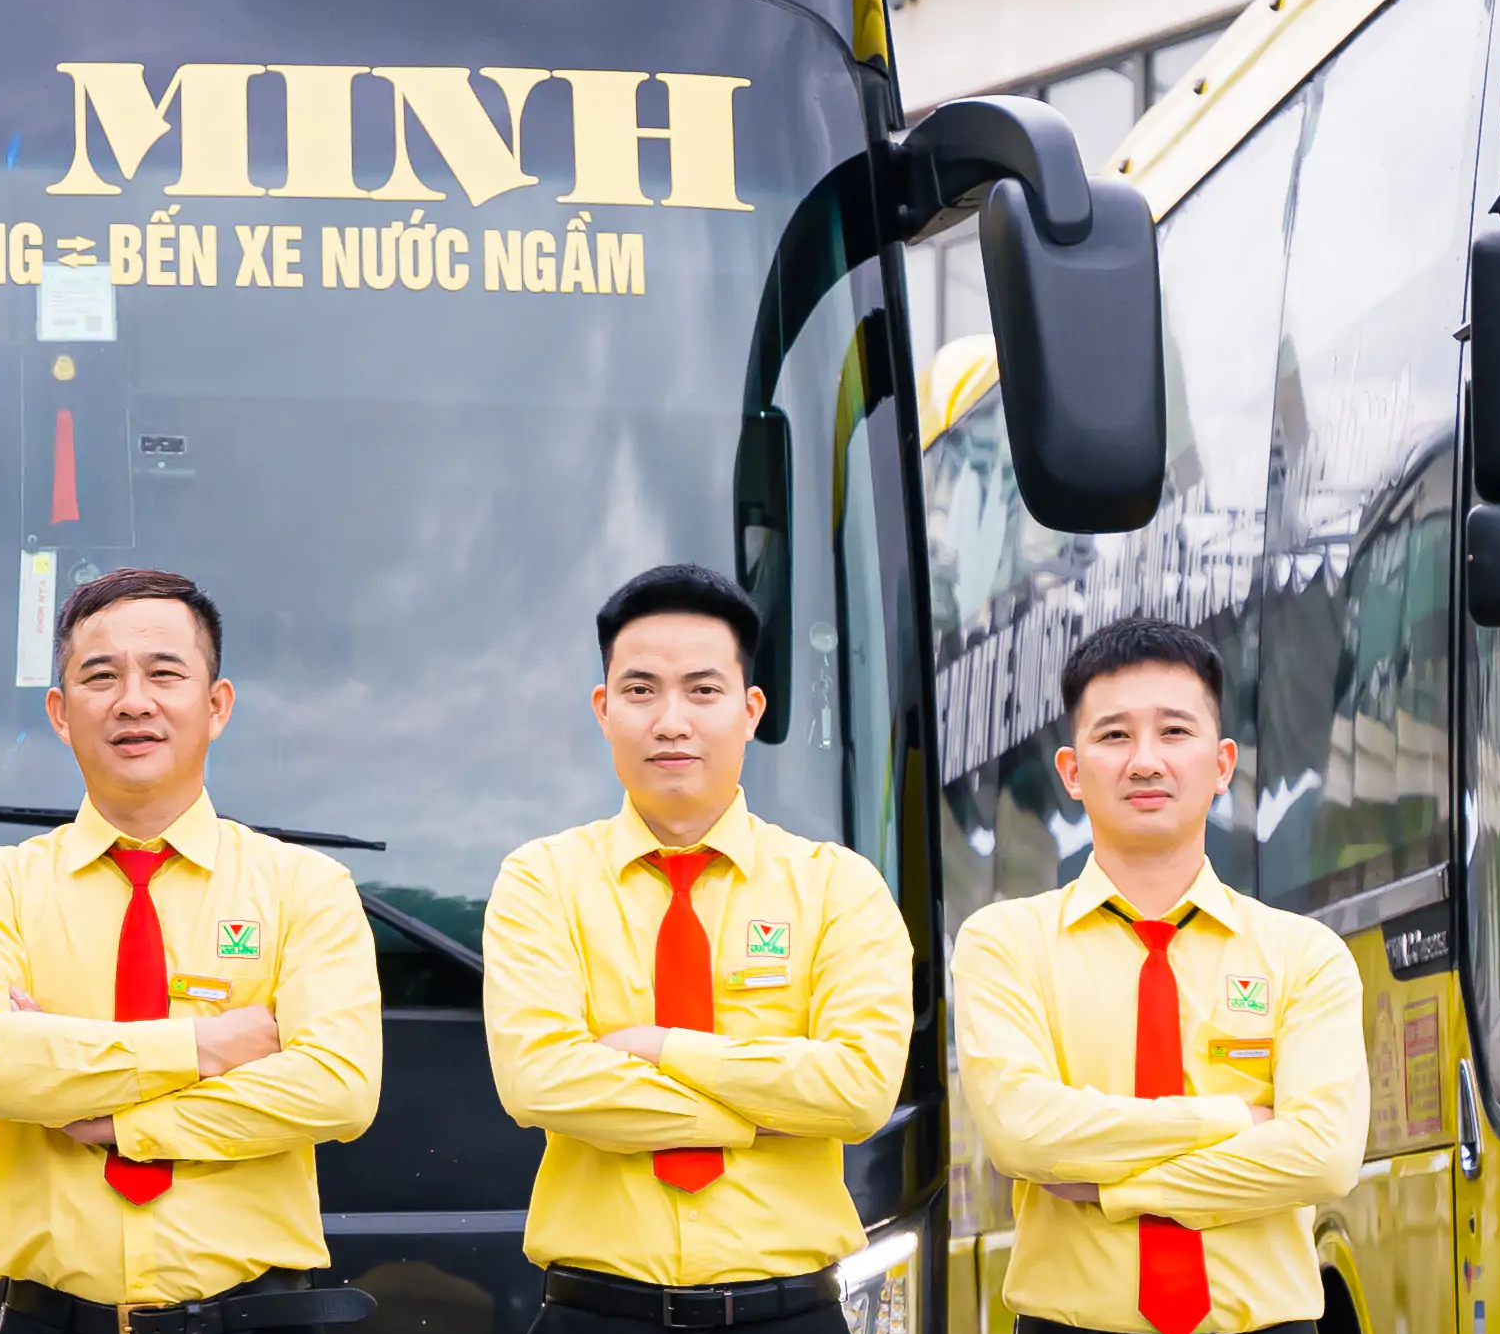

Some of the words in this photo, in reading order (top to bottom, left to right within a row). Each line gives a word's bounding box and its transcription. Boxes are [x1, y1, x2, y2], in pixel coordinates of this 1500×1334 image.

[45, 63, 755, 212] MINH
[109, 205, 217, 286] BẾN
[234, 225, 304, 287] XE
[321, 208, 470, 291] NƯỚC
[483, 211, 646, 296] NGẦM
